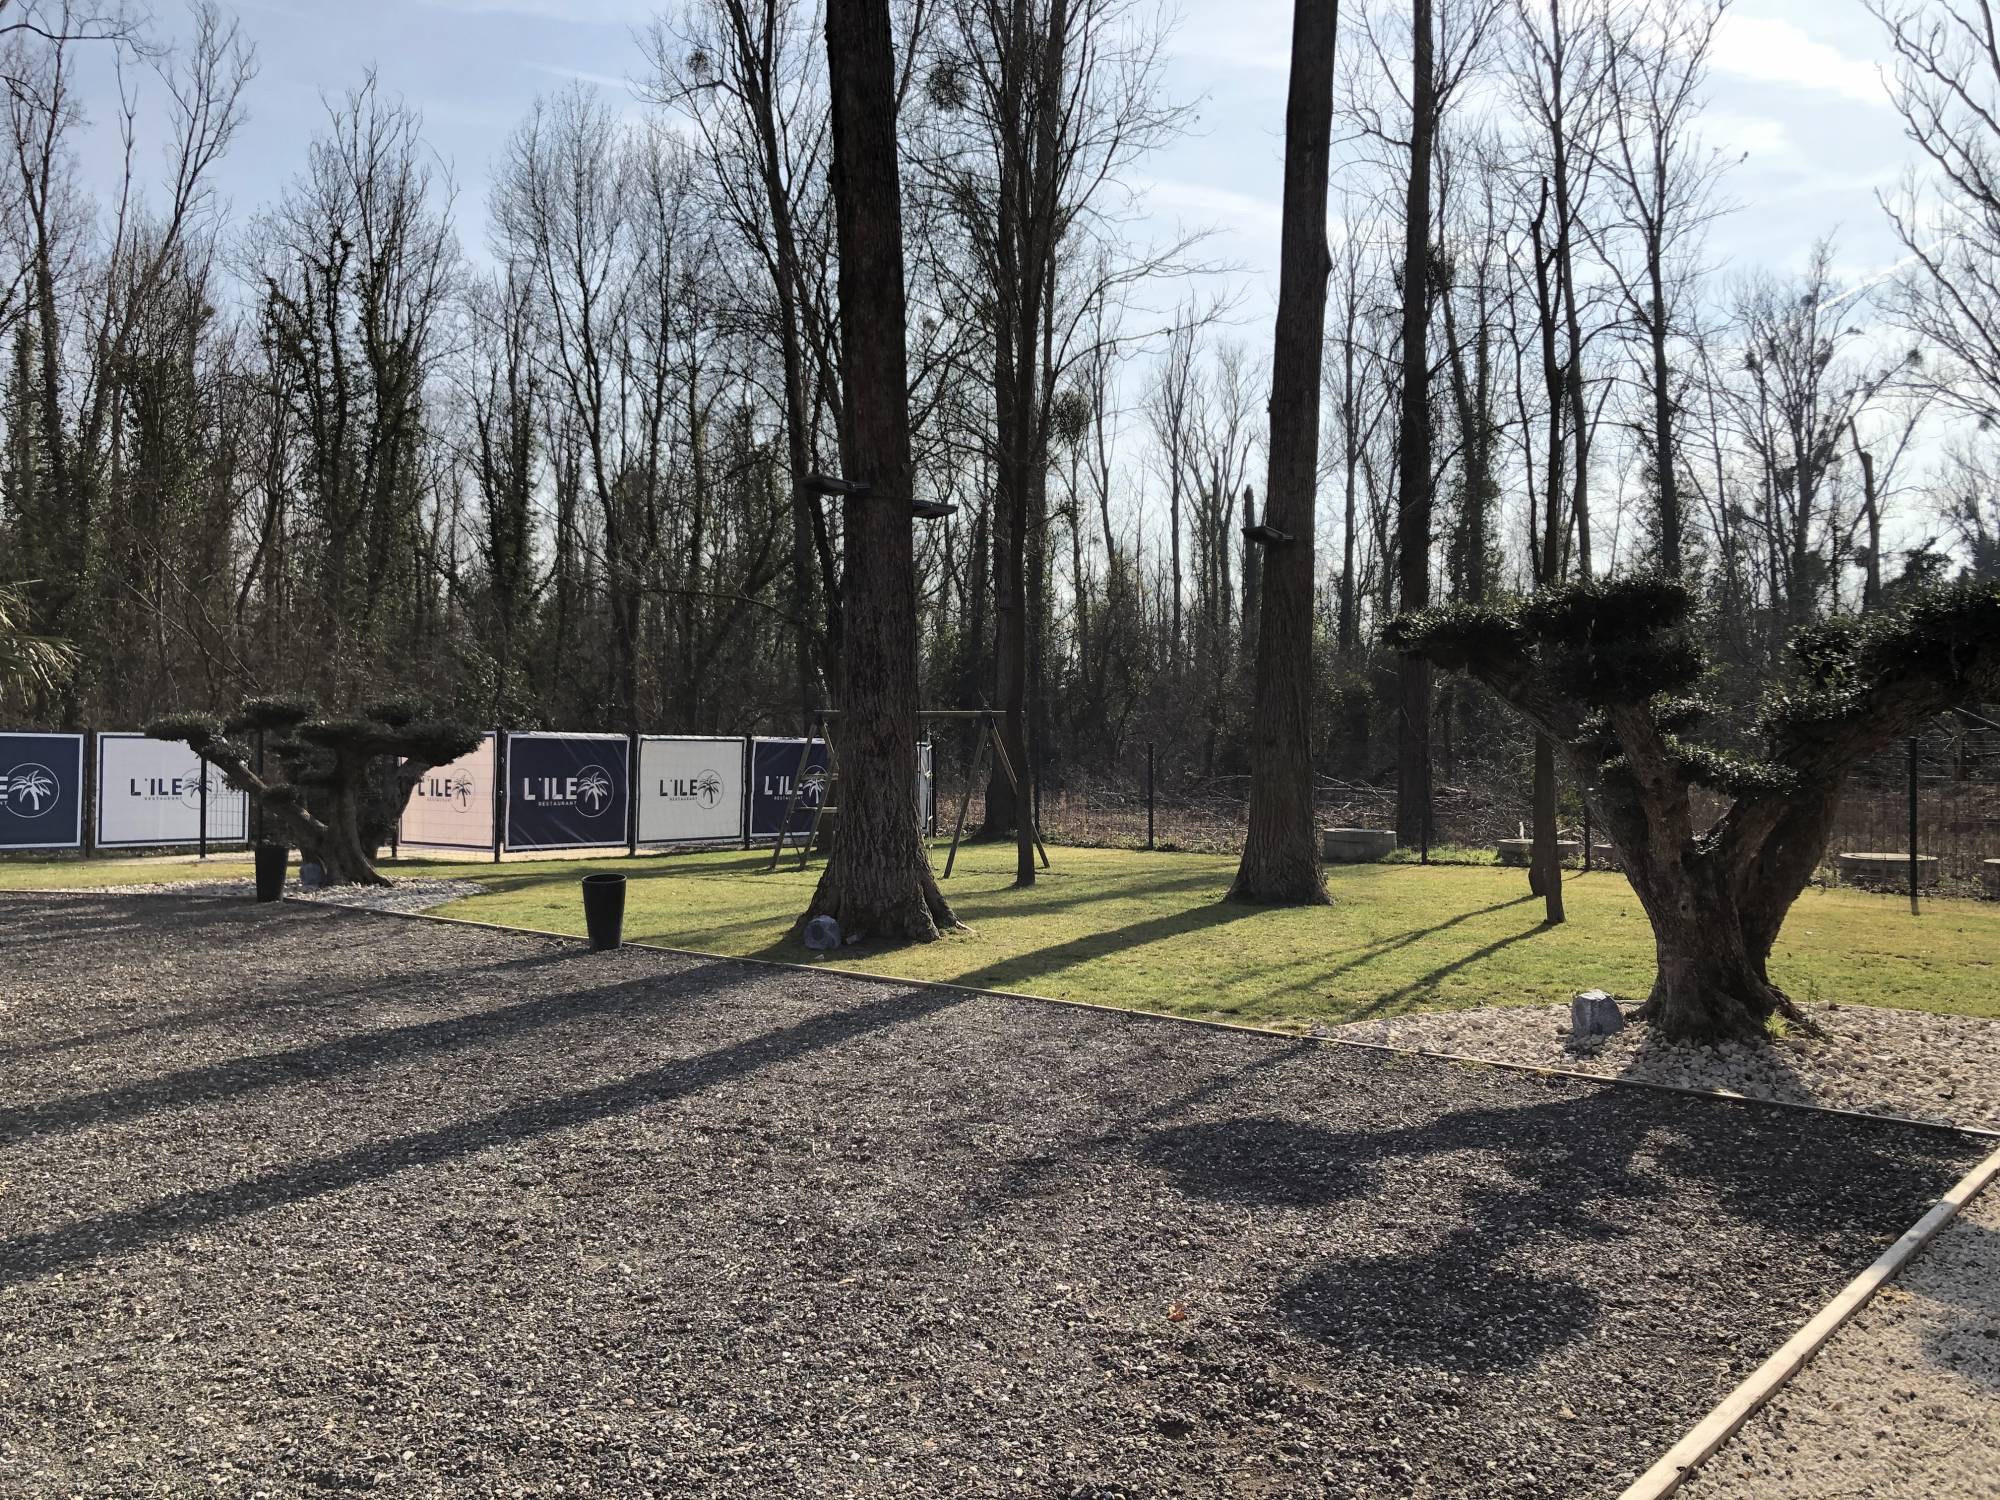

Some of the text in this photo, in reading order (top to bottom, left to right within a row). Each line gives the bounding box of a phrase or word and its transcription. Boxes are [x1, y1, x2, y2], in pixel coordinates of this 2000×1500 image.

[131, 778, 182, 796] L'ILE
[524, 777, 577, 800] L'ILE
[660, 779, 697, 797] L'ILE
